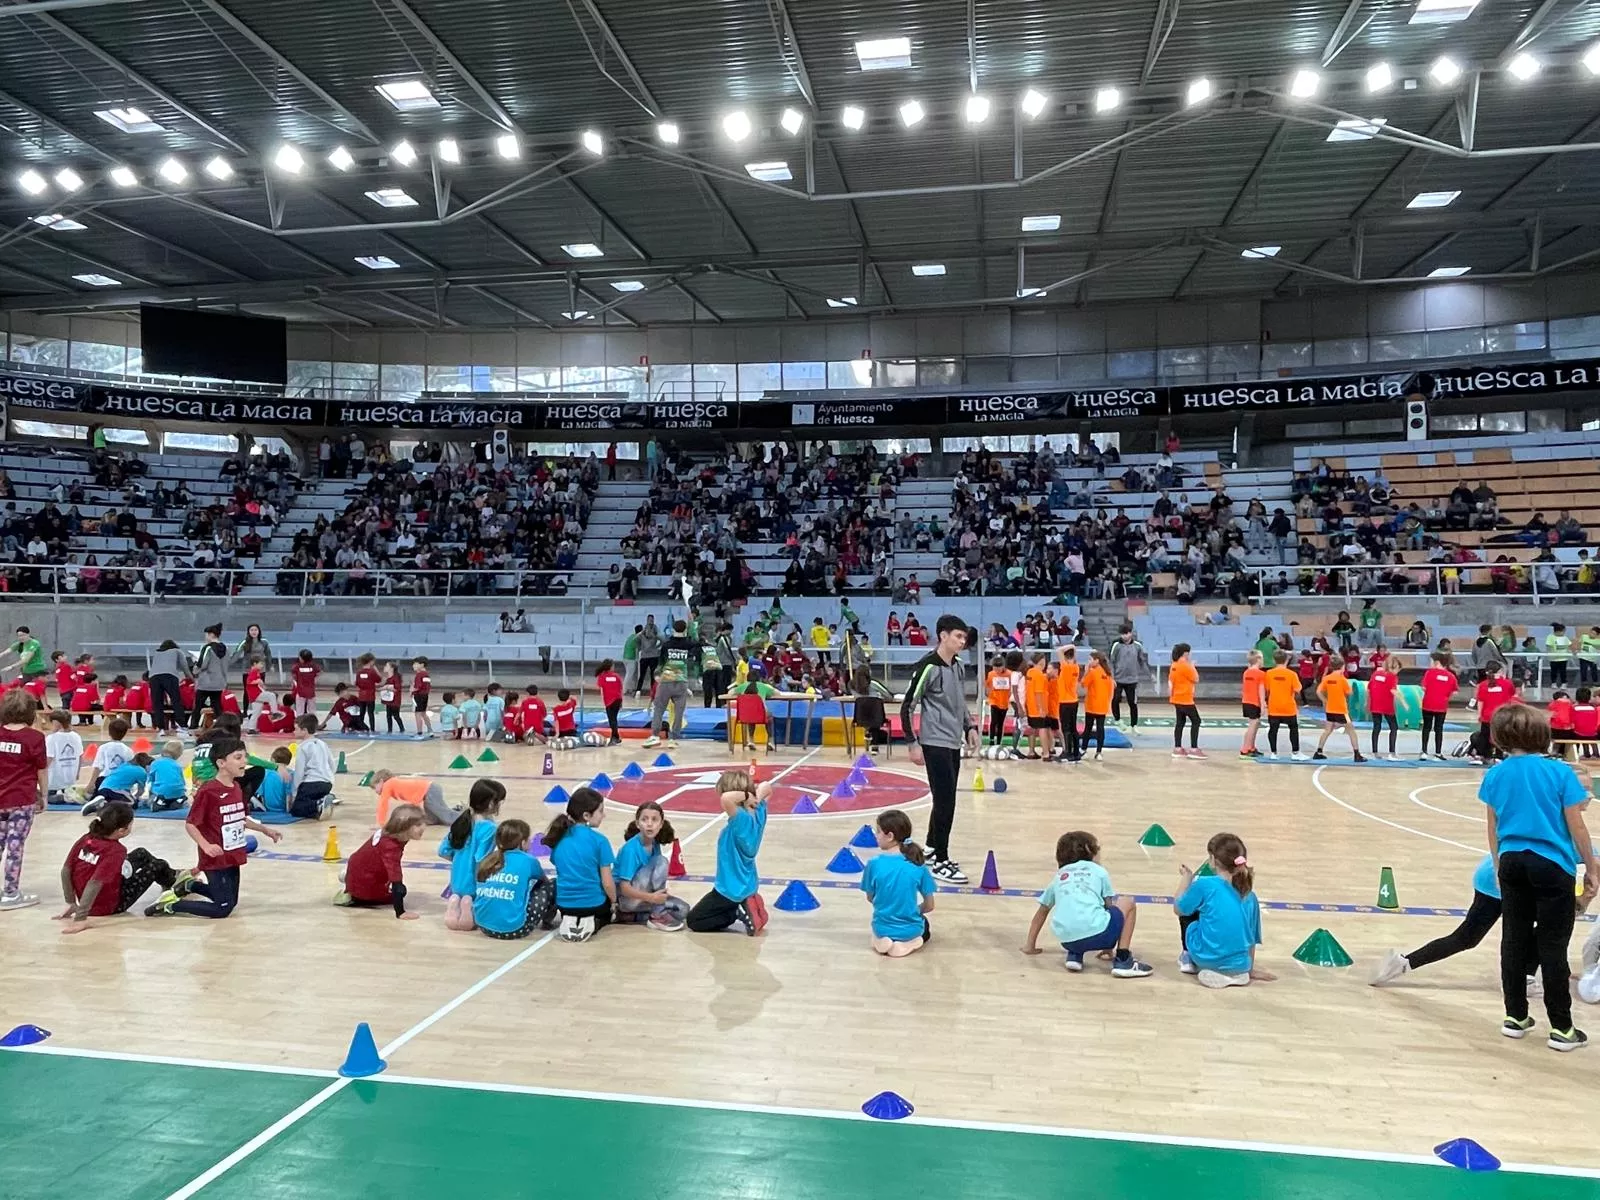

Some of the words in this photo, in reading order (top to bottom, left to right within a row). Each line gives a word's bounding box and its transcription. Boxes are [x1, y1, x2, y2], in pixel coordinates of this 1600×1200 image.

[818, 403, 894, 415] Ayuntamiento
[817, 415, 831, 425] de
[834, 414, 875, 424] Huesca
[545, 758, 552, 769] 5
[1380, 883, 1390, 898] 4
